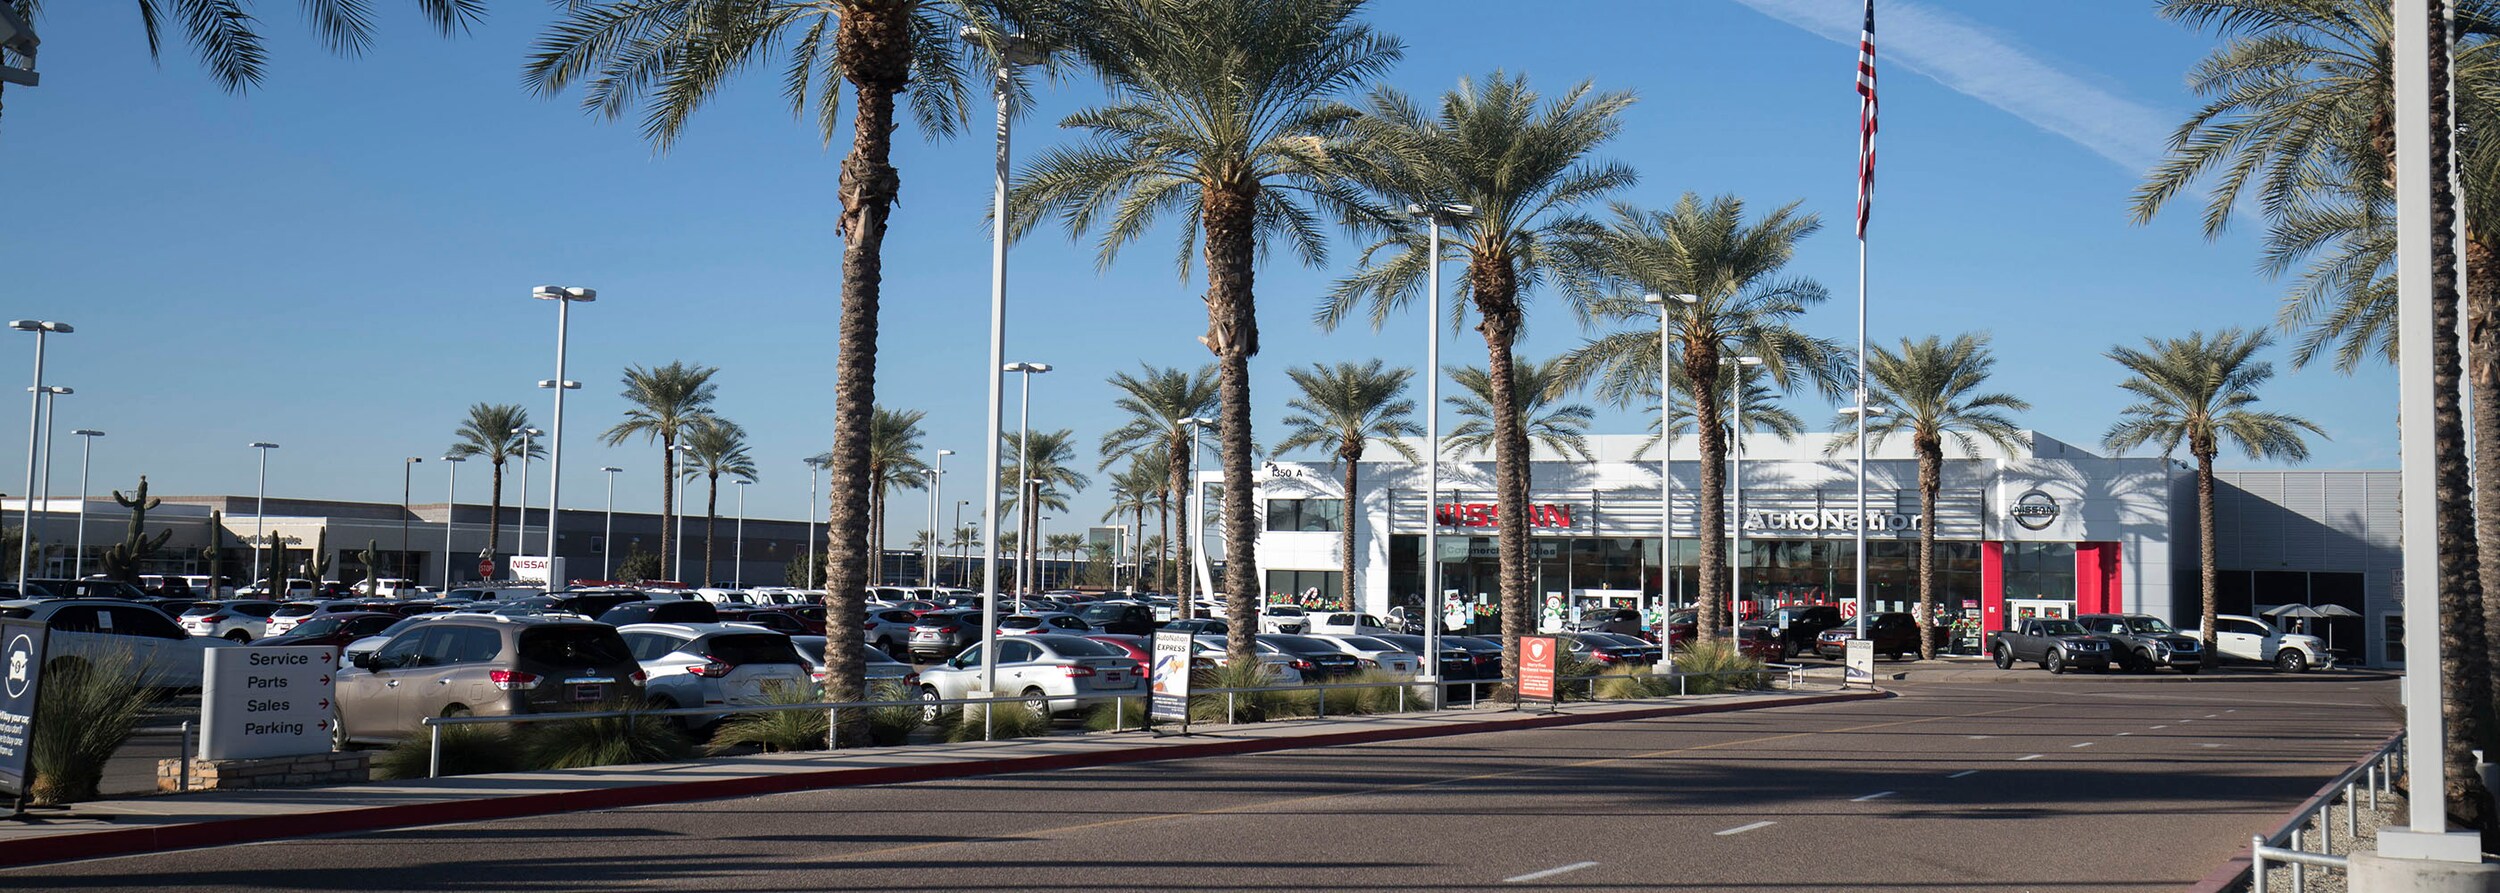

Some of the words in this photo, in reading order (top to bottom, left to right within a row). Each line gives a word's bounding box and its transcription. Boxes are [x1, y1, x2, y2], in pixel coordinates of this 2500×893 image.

[1272, 469, 1291, 477] 1350
[1296, 469, 1302, 477] A
[1743, 508, 1922, 530] AutoNation
[480, 564, 492, 572] STOP
[1156, 634, 1188, 642] AutoNation
[1157, 644, 1186, 652] EXPRESS
[250, 652, 308, 666] Service
[248, 676, 288, 688] Parts
[247, 699, 290, 712] Sales
[245, 722, 303, 736] Parking
